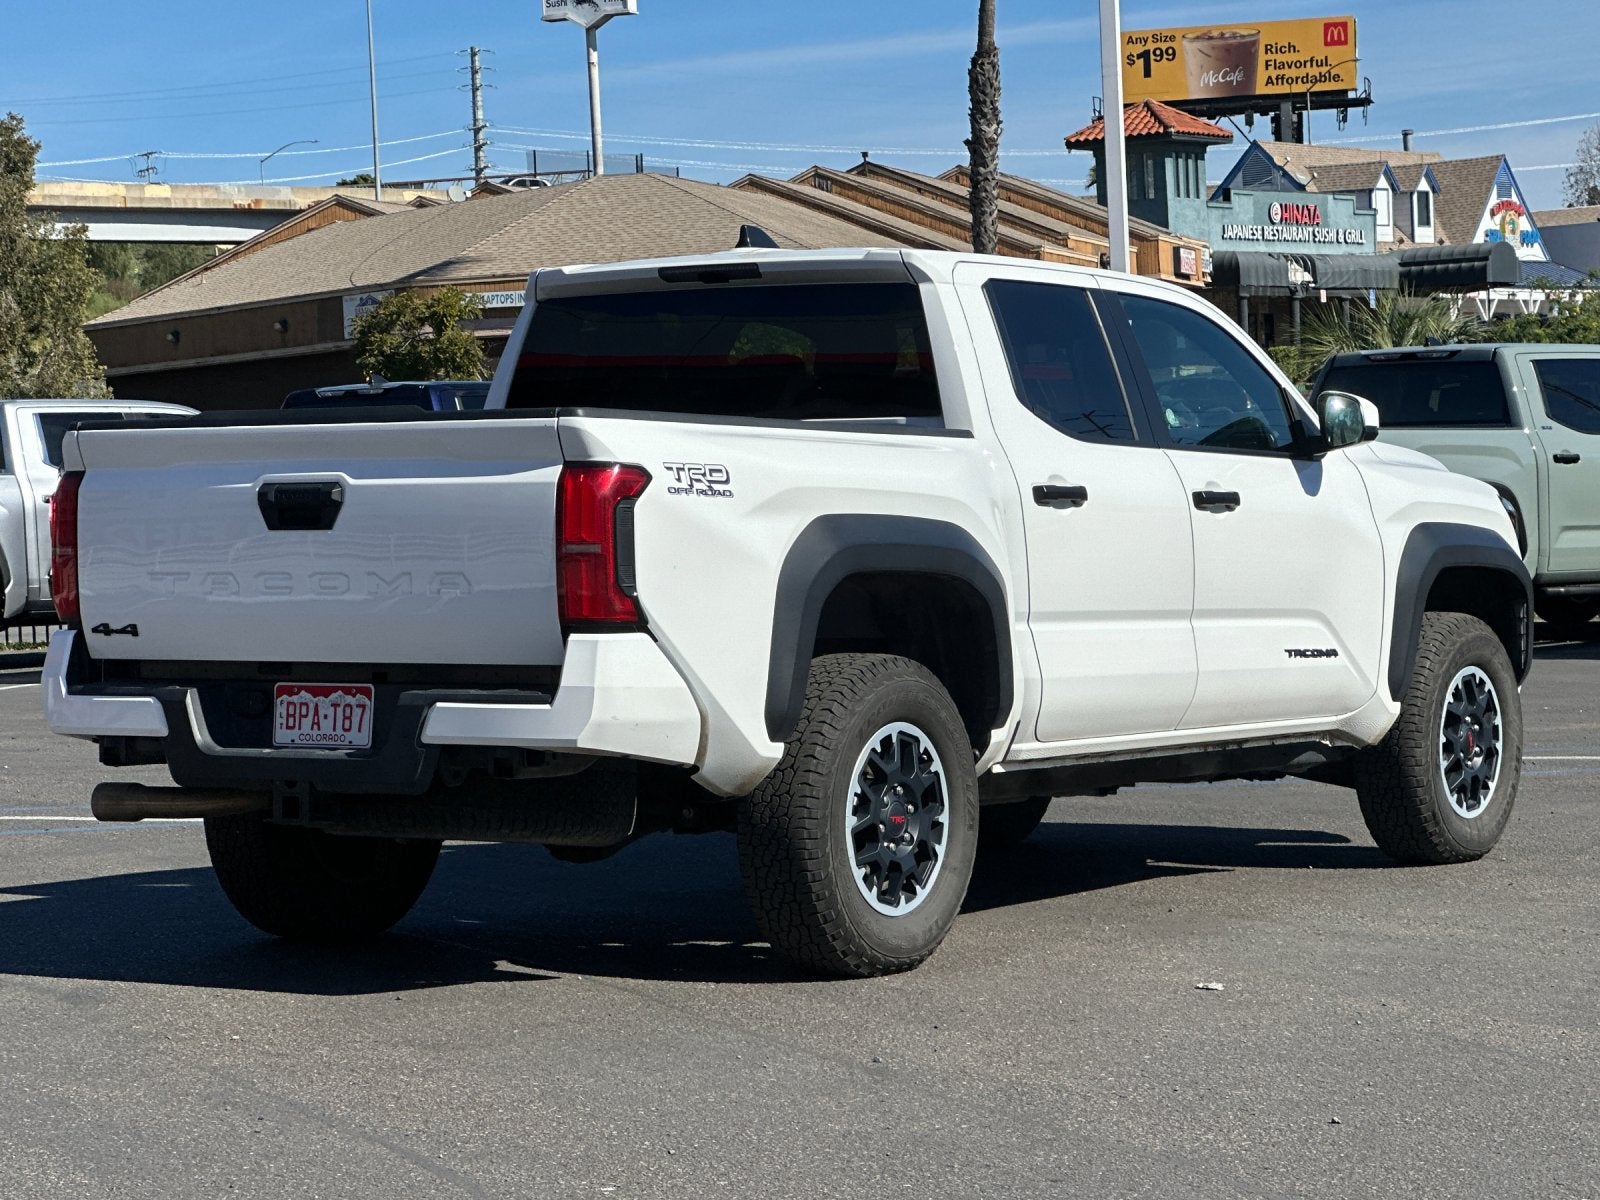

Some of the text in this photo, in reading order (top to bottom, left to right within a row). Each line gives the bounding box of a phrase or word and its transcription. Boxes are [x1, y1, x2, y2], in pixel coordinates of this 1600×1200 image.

[1126, 33, 1176, 46] Any Size
[1264, 42, 1300, 55] Rich.
[1264, 56, 1332, 70] Flavorful.
[1264, 70, 1344, 87] Affordable.
[1223, 225, 1366, 244] JAPANESE RESTAURANT SUSHI & GRILL
[663, 462, 730, 488] TRD
[668, 487, 733, 498] OFF ROAD
[149, 571, 472, 596] TACOMA
[1284, 649, 1338, 658] TACOMA
[299, 733, 345, 742] COLORADO
